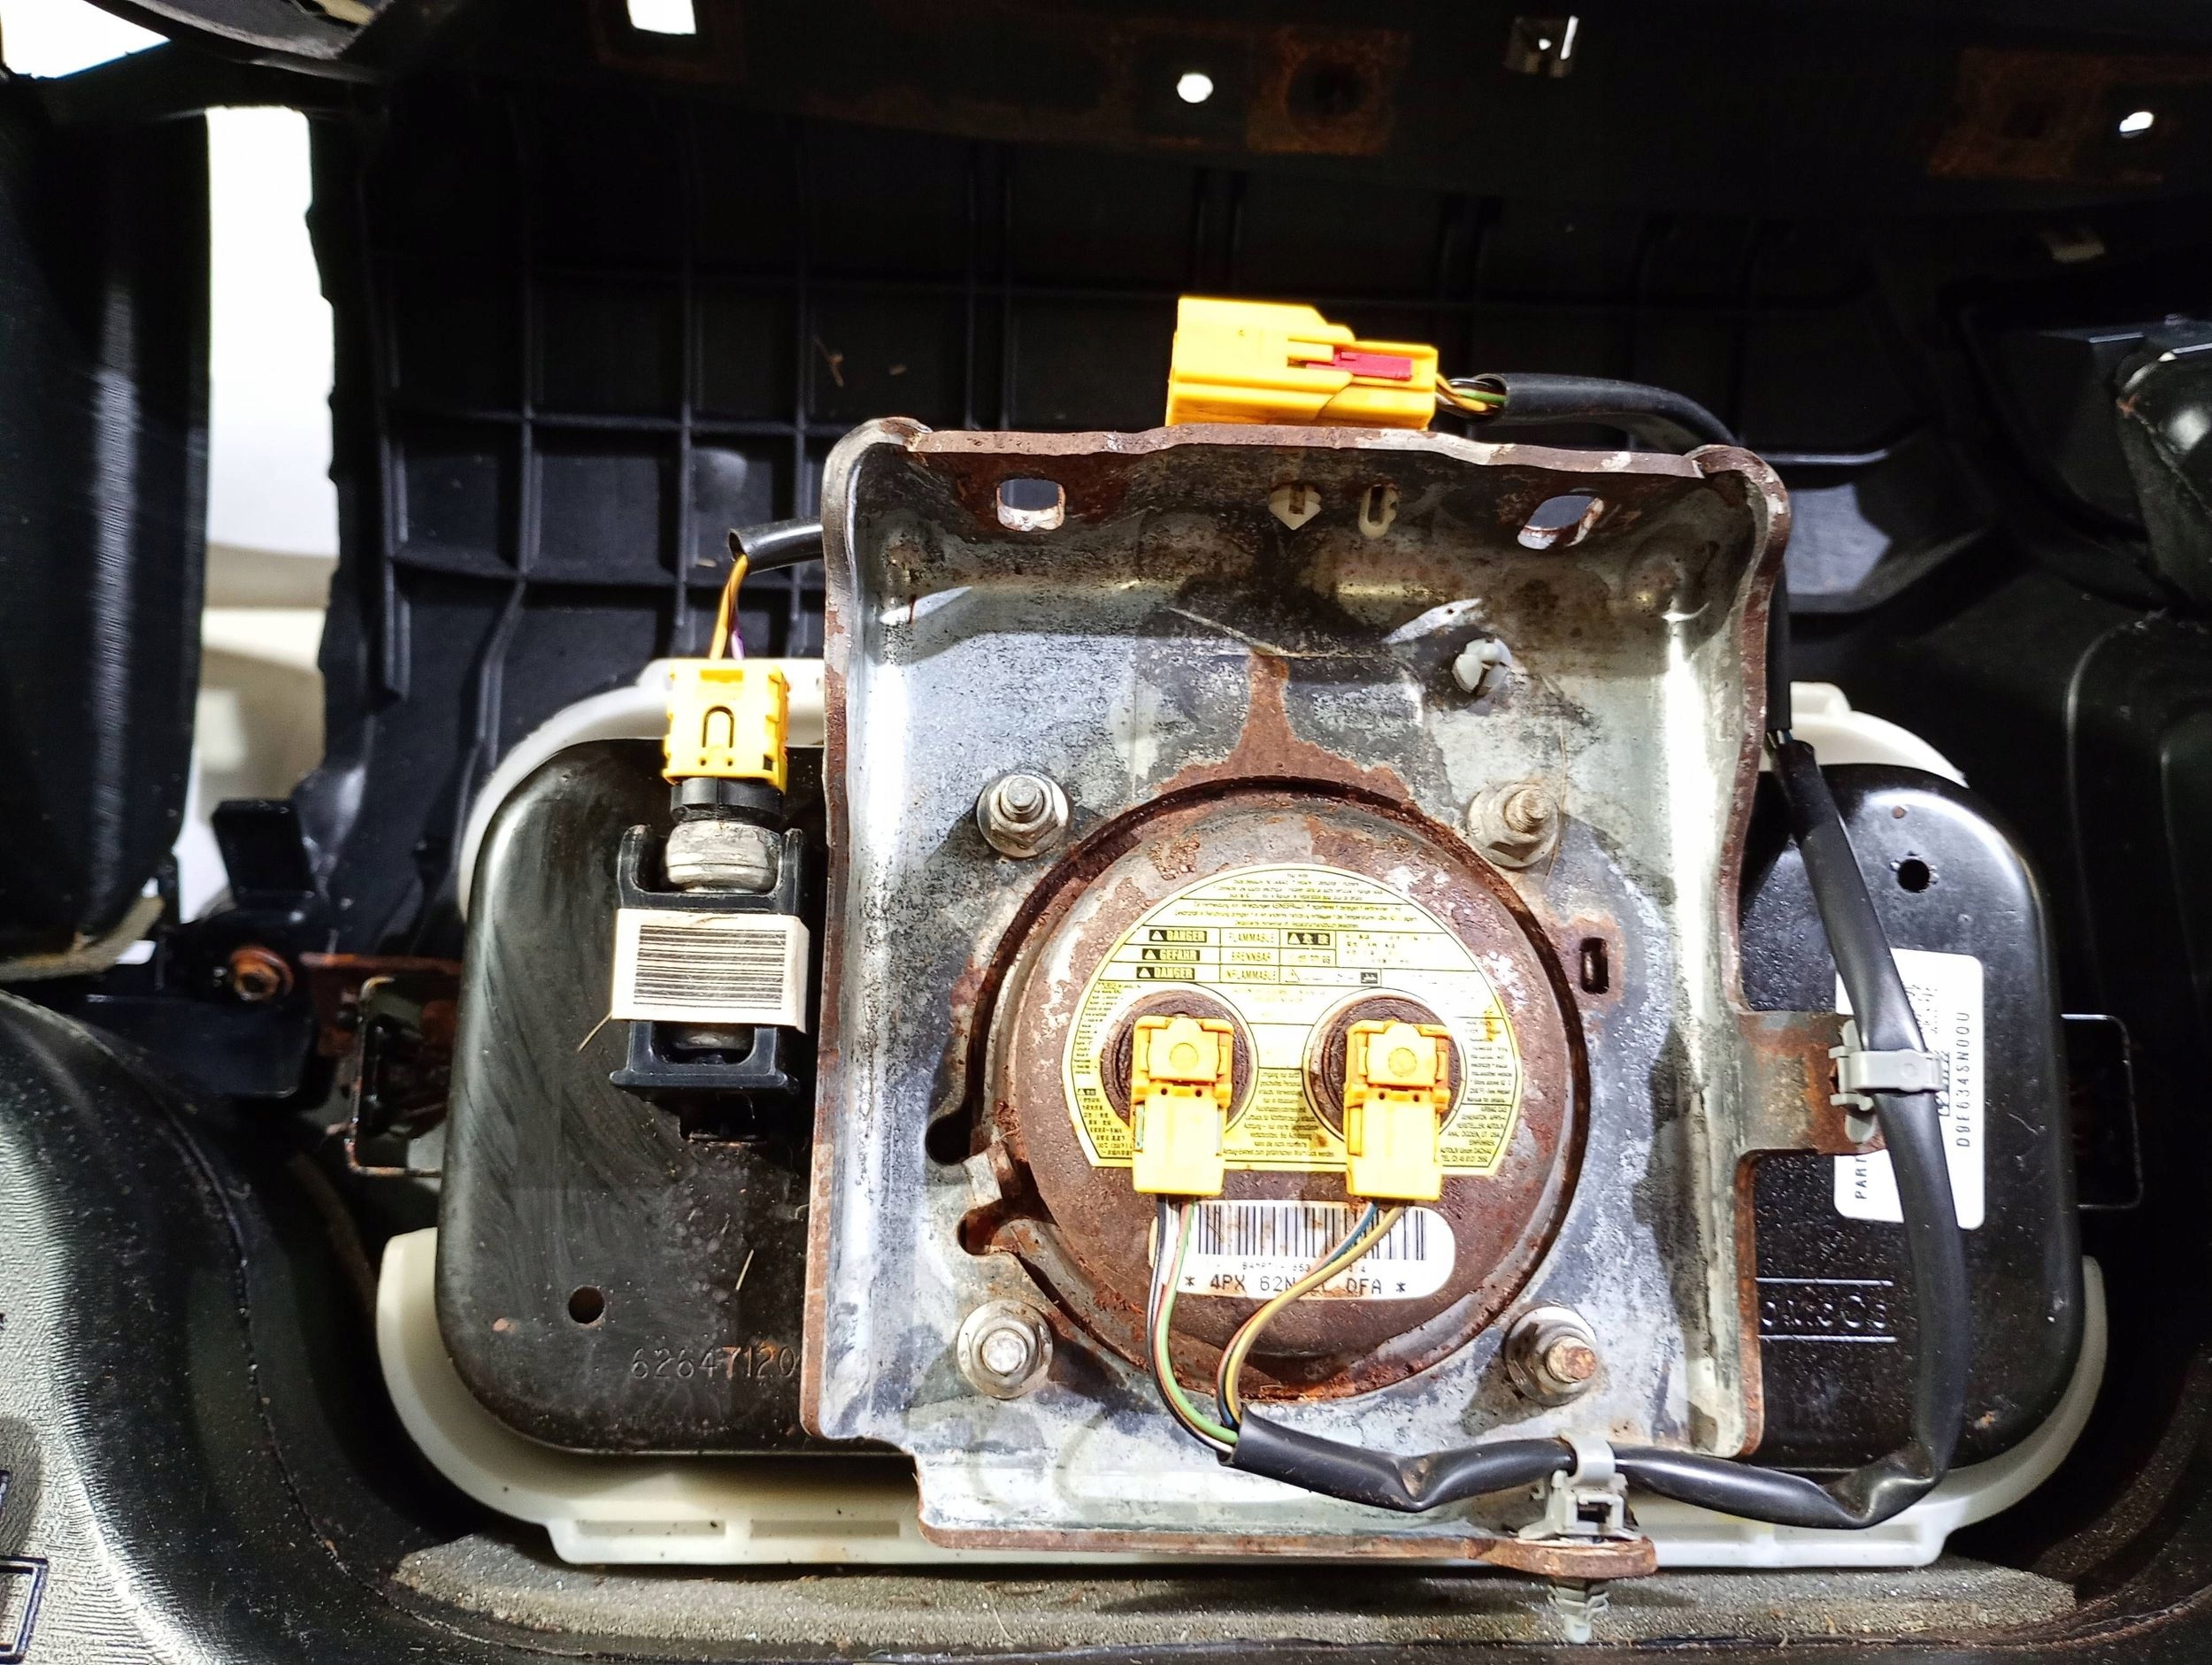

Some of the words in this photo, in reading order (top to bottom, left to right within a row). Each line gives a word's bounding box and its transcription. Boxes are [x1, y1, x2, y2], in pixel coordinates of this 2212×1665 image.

[1166, 931, 1206, 942] DANGER
[1160, 949, 1197, 961] GEFAHR
[1154, 967, 1194, 978] DANGER
[1225, 970, 1276, 980] NFLAMMABLE
[1210, 1274, 1244, 1291] 4PX
